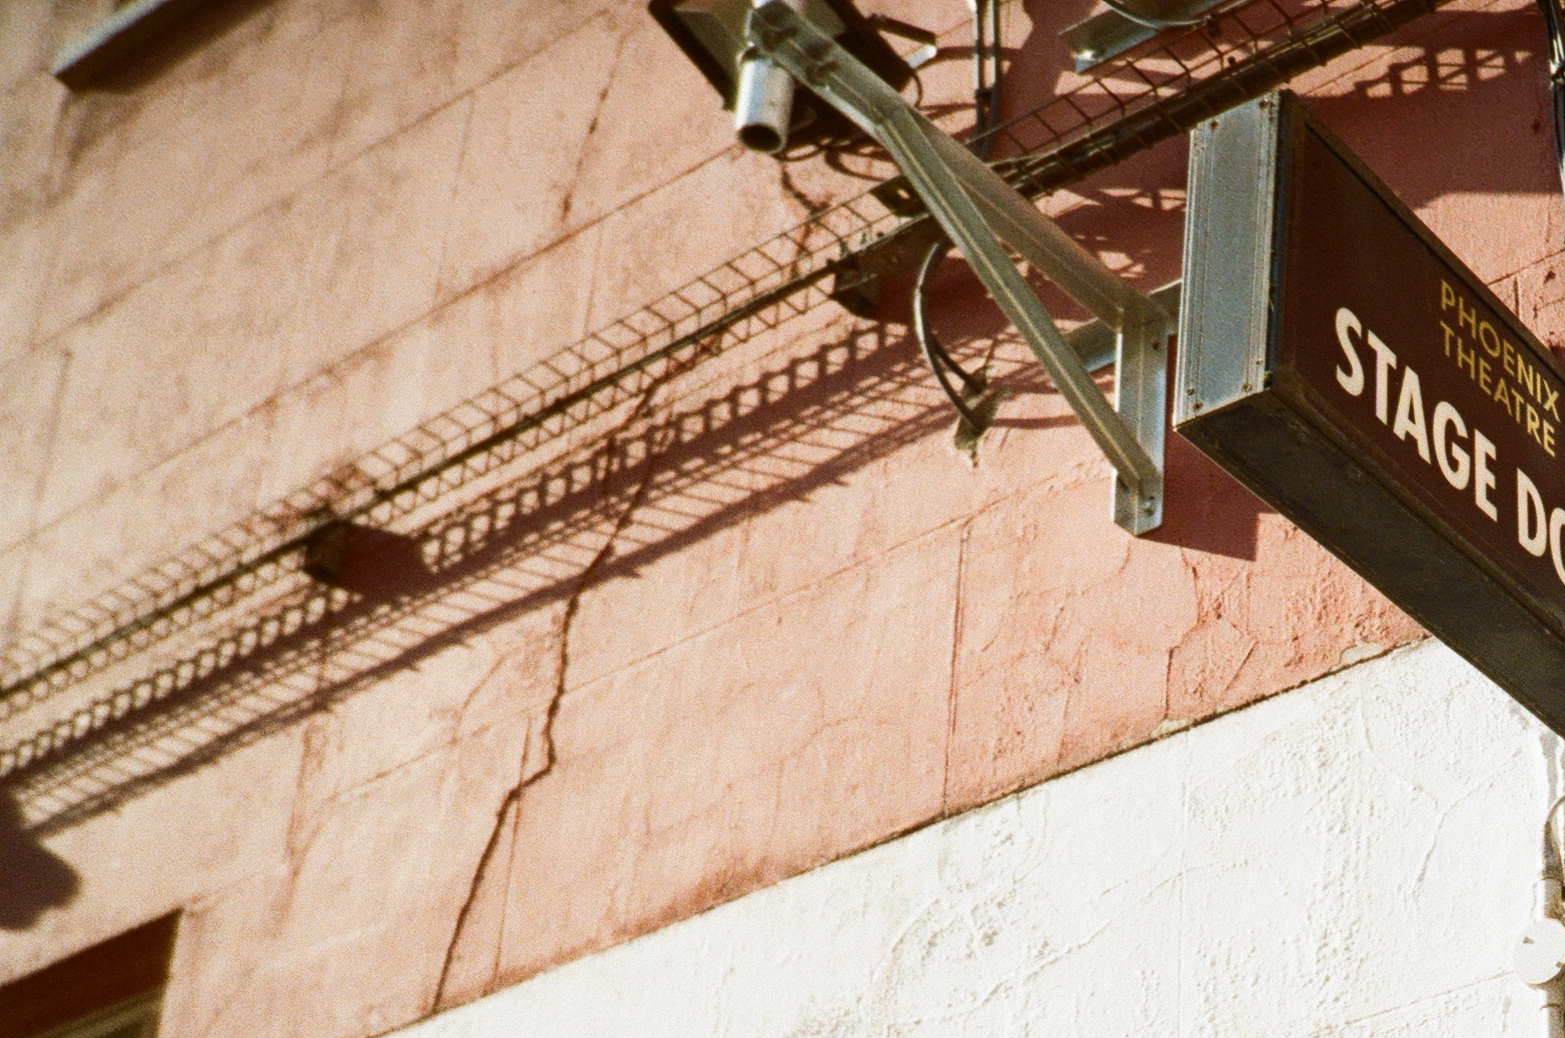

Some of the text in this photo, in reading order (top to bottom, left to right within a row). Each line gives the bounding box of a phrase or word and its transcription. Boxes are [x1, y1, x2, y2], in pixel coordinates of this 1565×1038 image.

[1336, 307, 1498, 522] STAGE
[1441, 322, 1556, 457] THEATRE
[1442, 280, 1561, 422] PHOENIX
